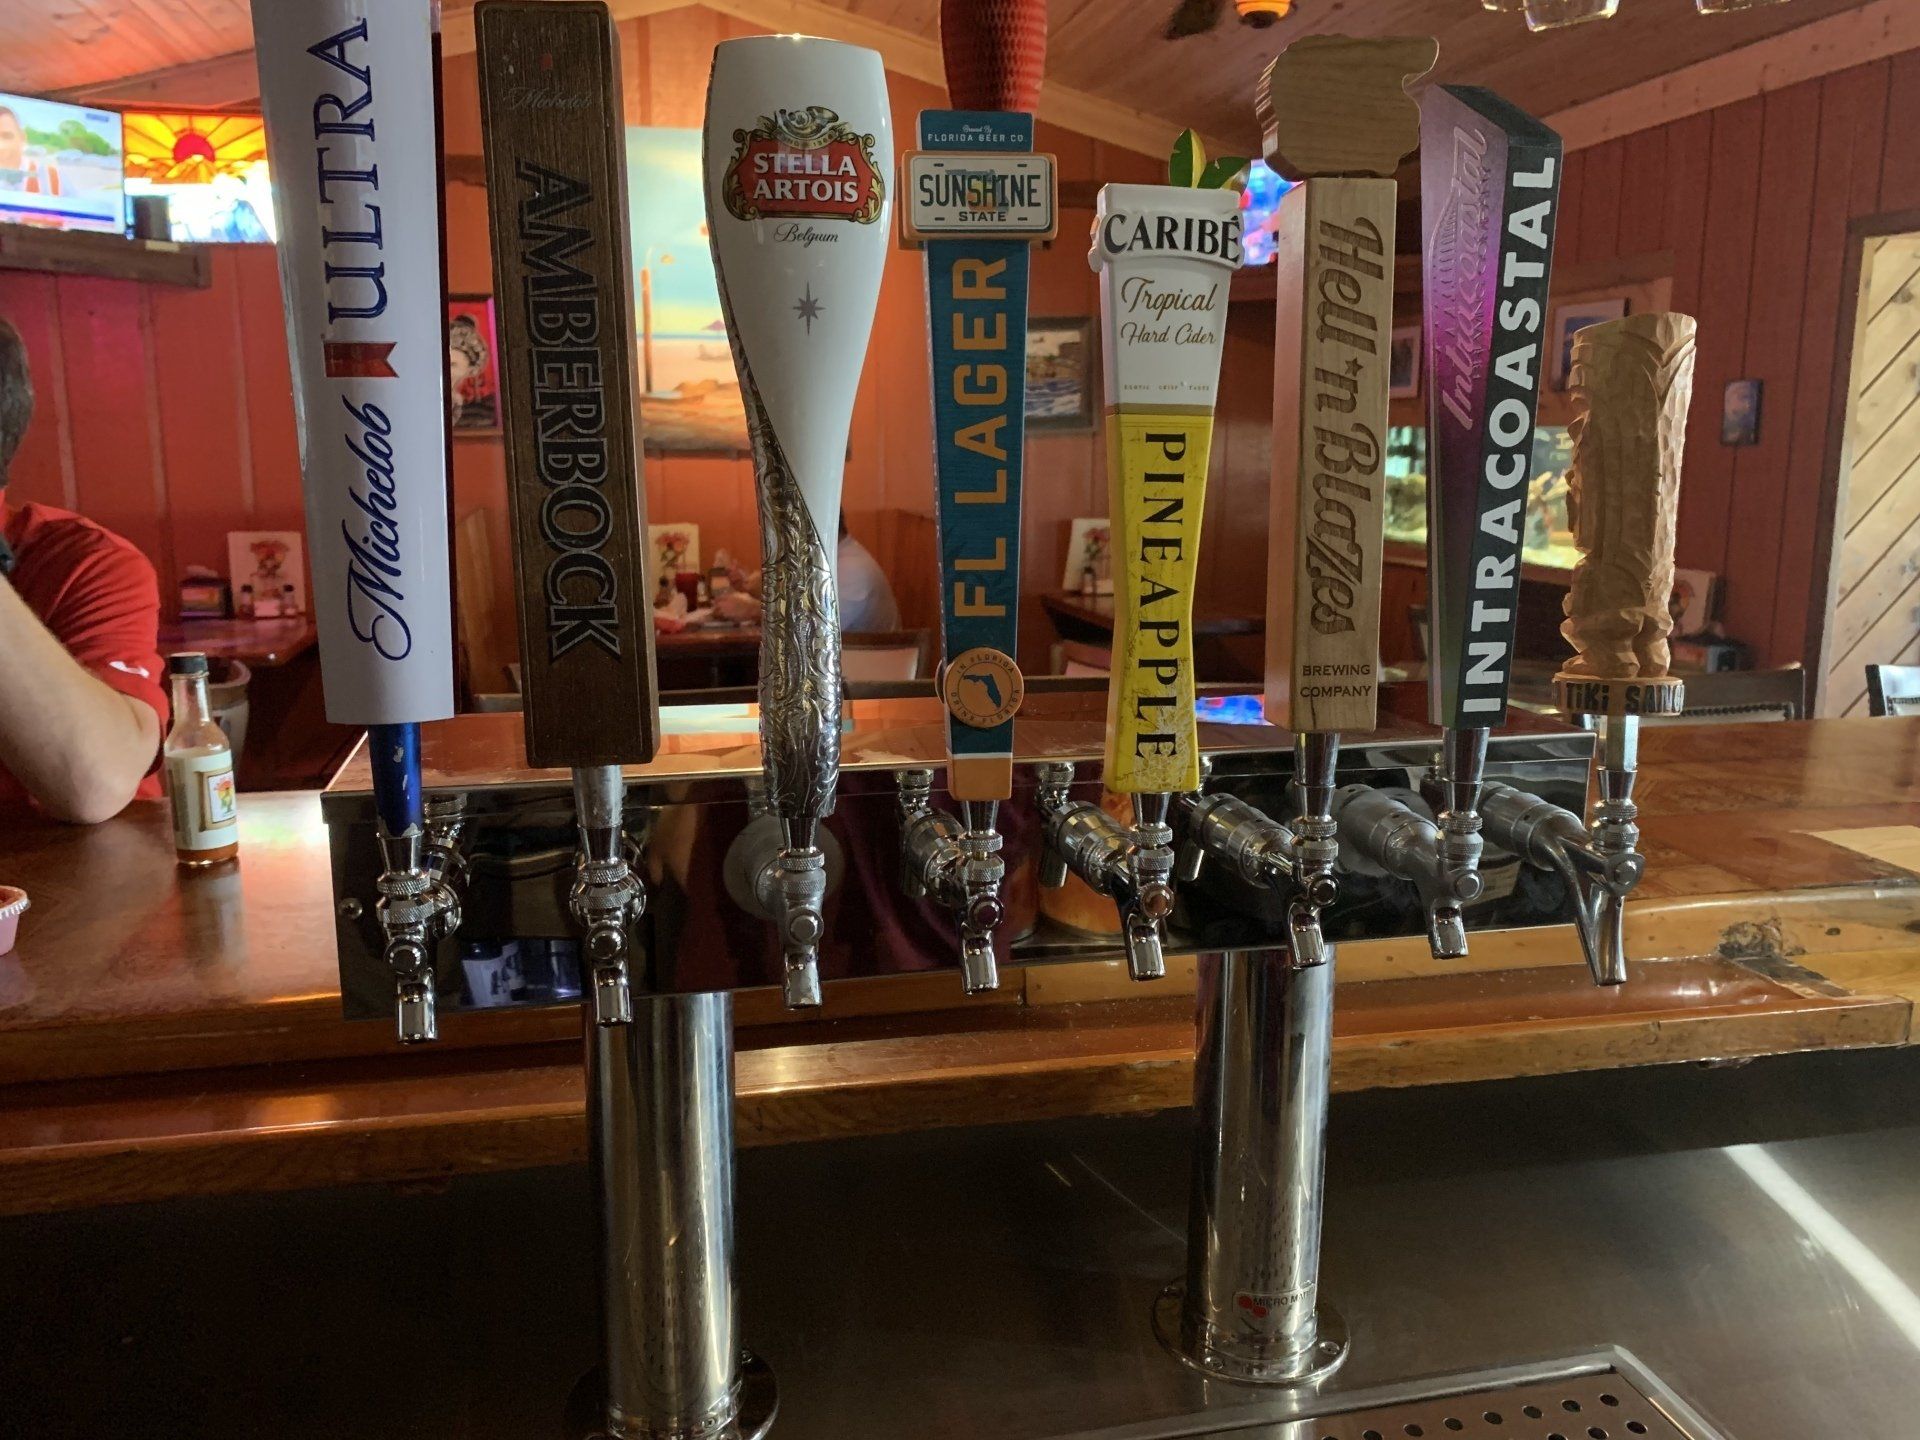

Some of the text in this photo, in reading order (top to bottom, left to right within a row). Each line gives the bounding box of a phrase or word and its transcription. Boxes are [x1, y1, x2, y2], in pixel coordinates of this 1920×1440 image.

[927, 134, 973, 142] FLORIDA
[978, 134, 1005, 142] BEER
[754, 153, 857, 177] STELLA
[753, 179, 859, 203] ARTOIS
[920, 174, 1041, 207] SUNSHINE
[958, 211, 1007, 222] STATE
[774, 223, 839, 248] Belgium
[1104, 214, 1240, 262] CARIBÉ
[1120, 277, 1218, 321] Tropical
[305, 17, 412, 661] Michelob ULTRA
[1120, 322, 1217, 346] Hard Cider
[515, 156, 620, 662] AMBERBOCK
[953, 258, 1008, 617] FL LAGER
[1463, 156, 1555, 714] INTRACOASTAL
[1136, 432, 1186, 758] PINEAPPLE
[1302, 664, 1371, 677] BREWING
[1300, 685, 1372, 698] COMPANY
